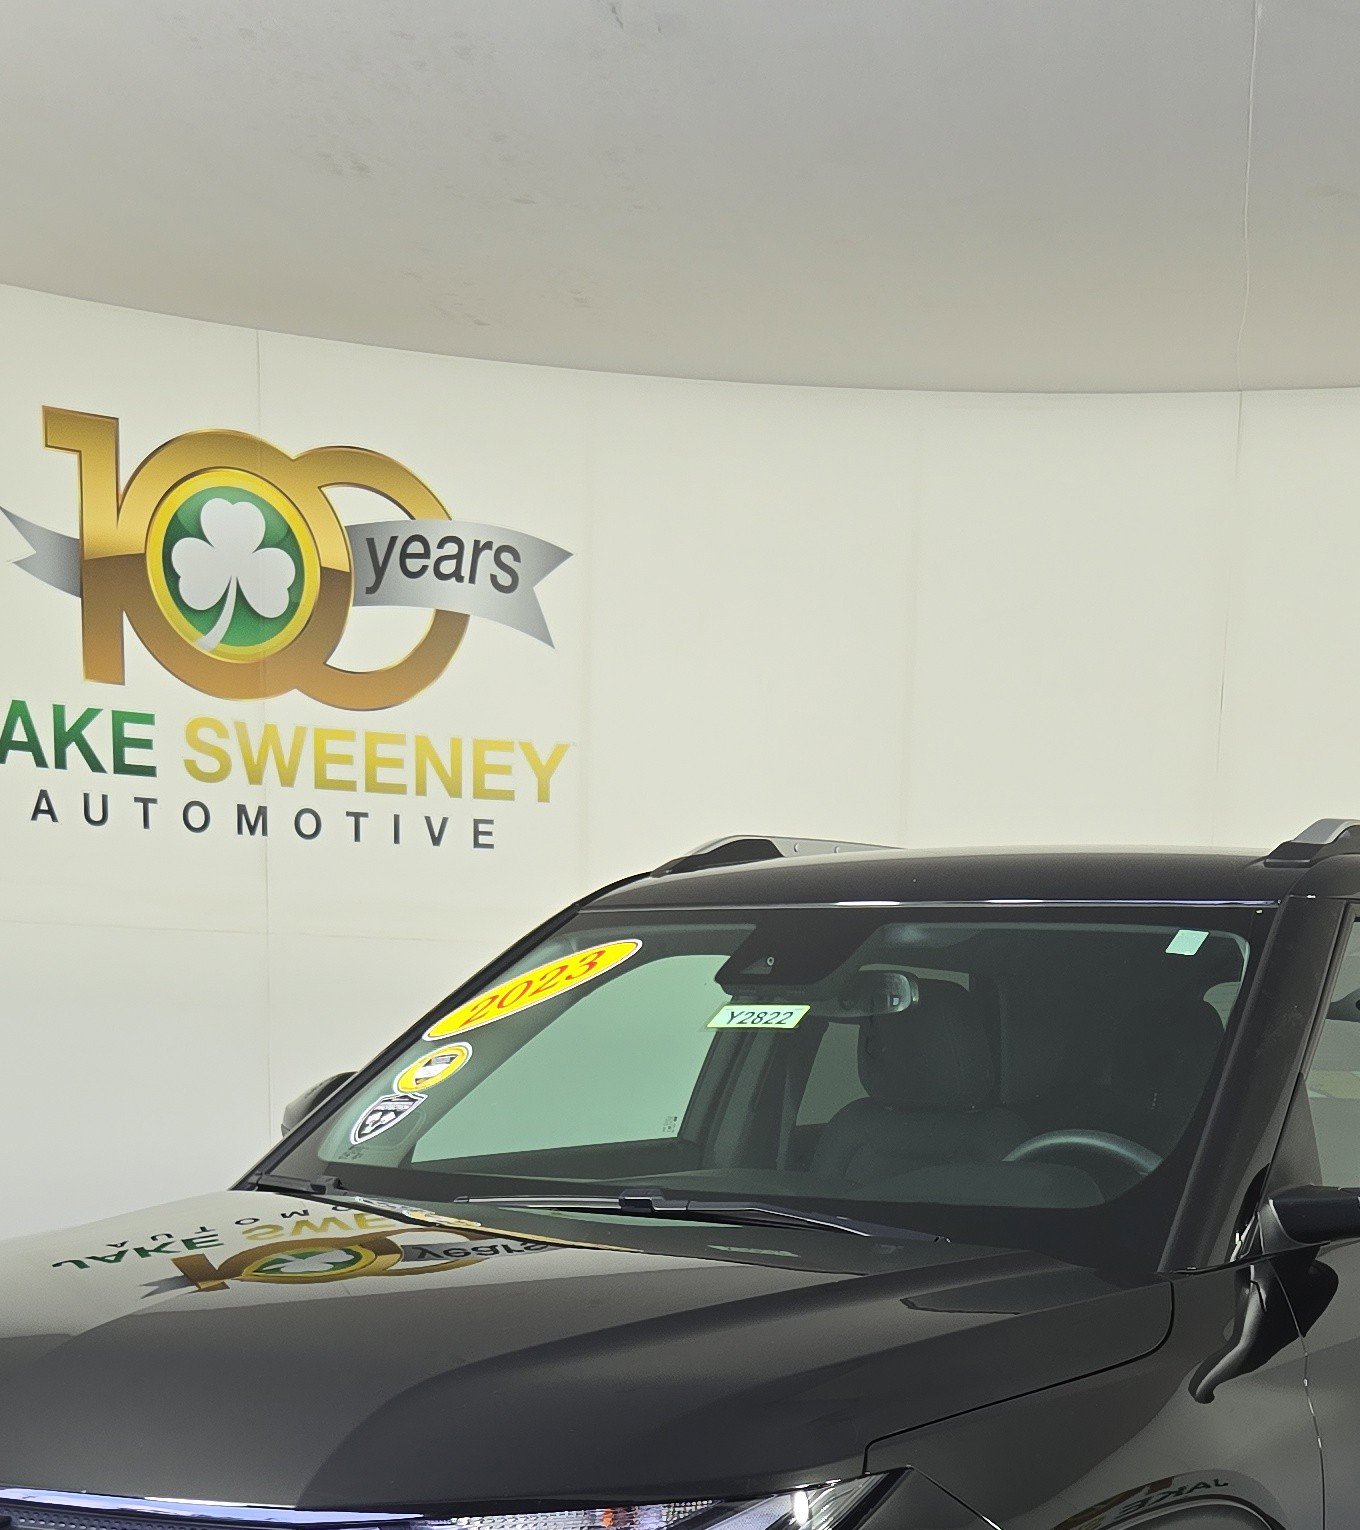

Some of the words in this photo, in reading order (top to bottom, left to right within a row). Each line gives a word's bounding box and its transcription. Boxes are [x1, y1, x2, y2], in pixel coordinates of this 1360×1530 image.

[365, 531, 521, 594] years
[183, 715, 570, 803] SWEENEY
[30, 788, 495, 850] AUTOMOTIVE
[458, 950, 606, 1028] 2023
[726, 1011, 794, 1025] Y2822
